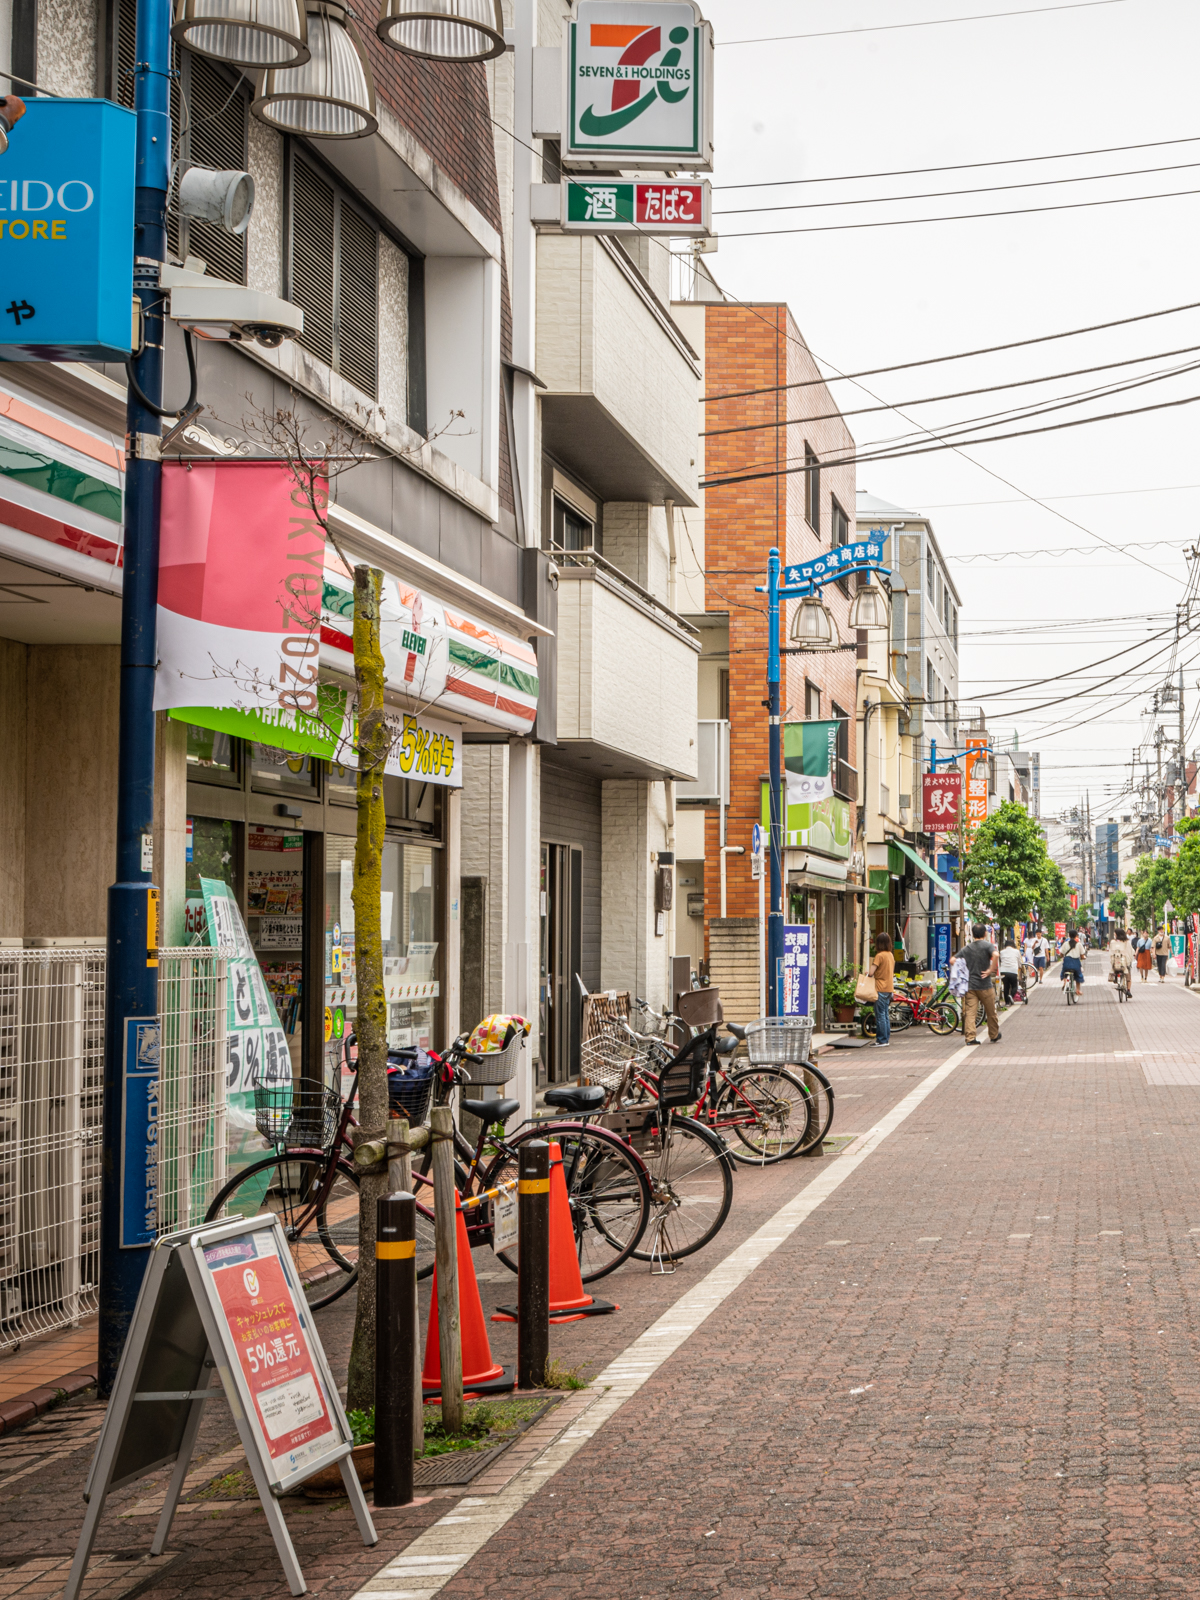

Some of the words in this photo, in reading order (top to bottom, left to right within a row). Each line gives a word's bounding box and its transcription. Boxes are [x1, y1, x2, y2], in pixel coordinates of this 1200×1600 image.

[631, 66, 691, 80] HOLDINGS
[584, 186, 618, 220] 酒
[645, 187, 695, 221] たばこ
[6, 300, 36, 326] や
[789, 544, 880, 582] 矢口の渡商店街
[400, 713, 455, 777] 5%付与
[928, 789, 957, 816] 駅
[185, 905, 206, 934] たば
[792, 966, 800, 1013] はじめました
[236, 1301, 287, 1329] キャッシュレスで
[241, 1317, 292, 1342] お支払いのお客様に
[246, 1333, 300, 1373] 5%還元
